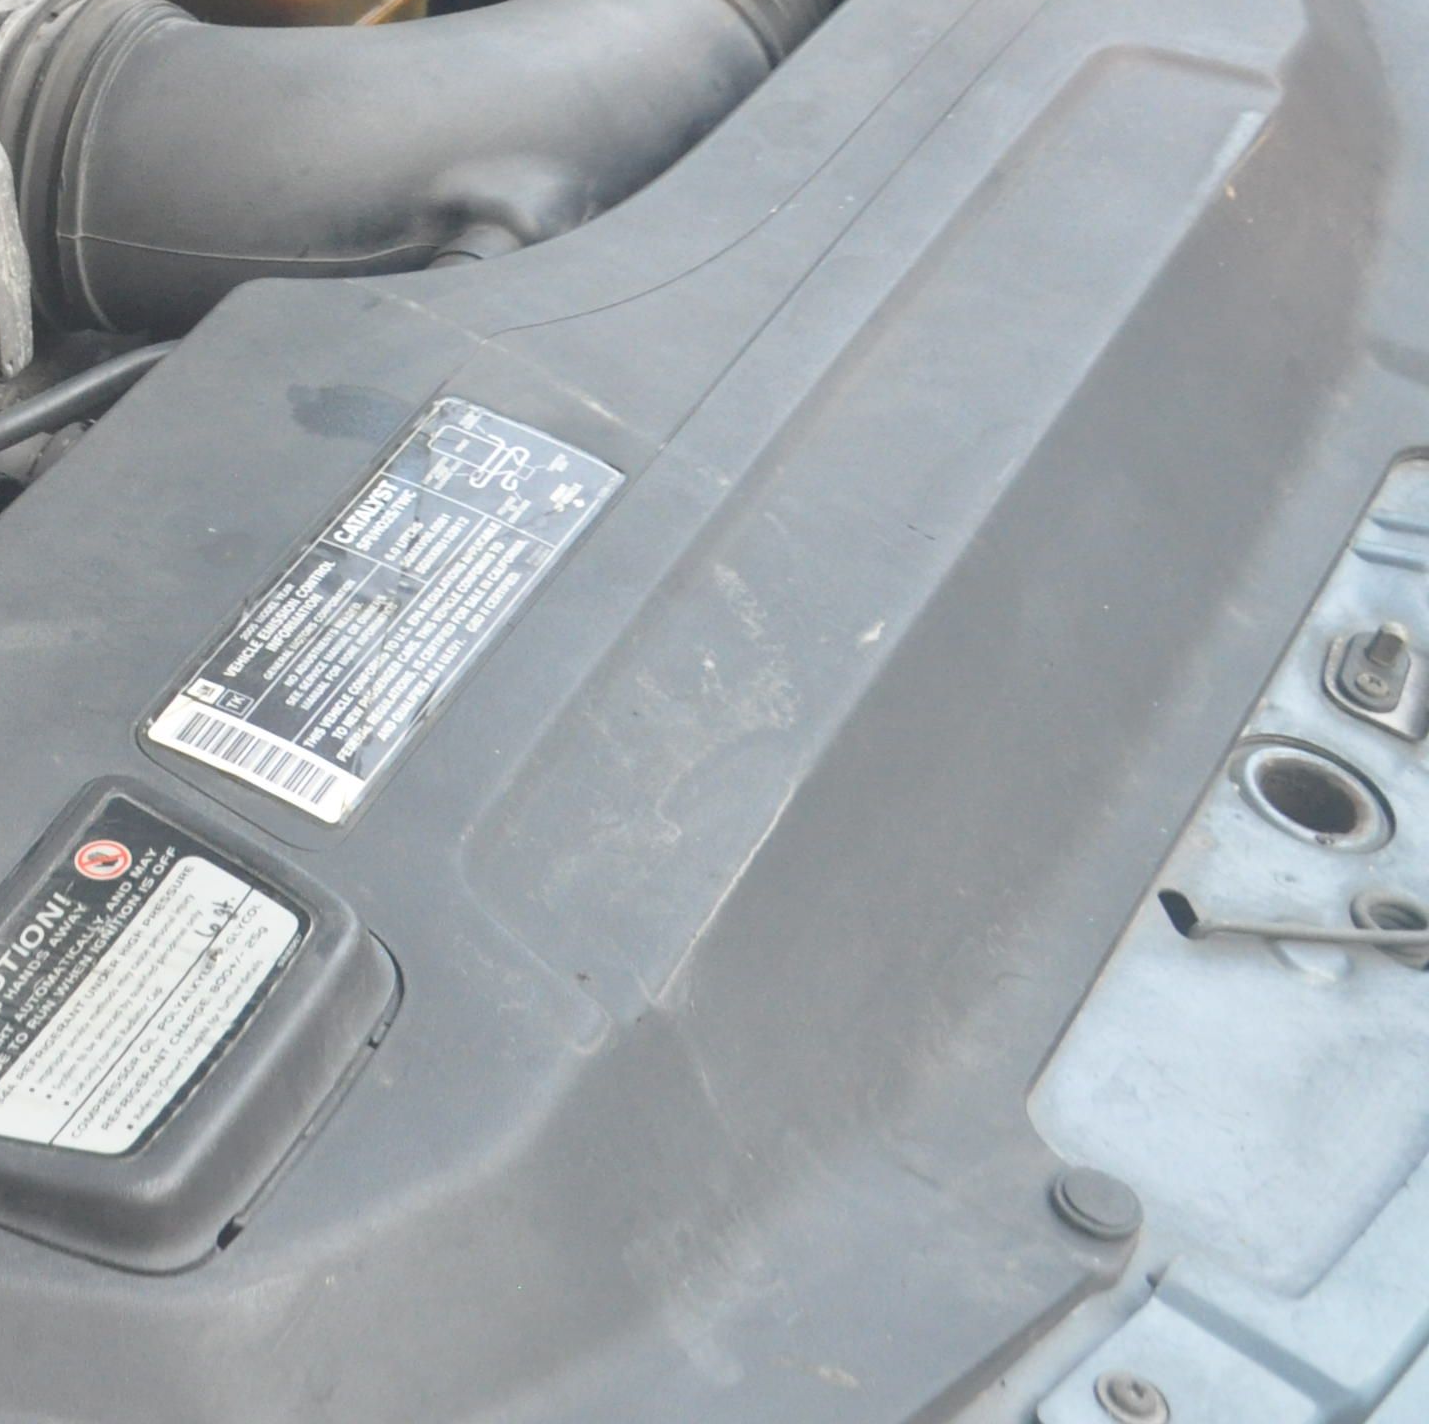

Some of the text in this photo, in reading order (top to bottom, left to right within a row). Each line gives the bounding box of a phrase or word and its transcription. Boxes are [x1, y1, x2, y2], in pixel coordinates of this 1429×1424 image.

[330, 478, 401, 545] CATALYST
[458, 520, 502, 564] APPLICABLE
[417, 560, 468, 612] REGULATIONS
[463, 587, 489, 609] SALE
[478, 578, 496, 591] IN
[223, 557, 336, 679] VEHICLE EMISSION CONTROL
[261, 577, 357, 681] GENERAL MOTORS CORPORATION
[264, 592, 324, 653] INFORMATION
[330, 724, 349, 740] TO
[340, 705, 366, 728] NEW
[356, 660, 405, 709] PASSENGER
[414, 619, 439, 640] THIS
[429, 590, 464, 623] VEHICLE
[454, 550, 497, 593] CONFORMS
[487, 540, 506, 554] TO
[391, 623, 414, 642] U.S.
[404, 608, 427, 627] EPA
[418, 621, 460, 662] CERTIFIED
[449, 605, 473, 625] FOR
[282, 673, 300, 687] NO
[293, 627, 340, 675] ADJUSTMENTS
[284, 689, 304, 706] SEE
[297, 659, 330, 691] SERVICE
[322, 633, 353, 662] MANUAL
[345, 622, 362, 635] OR
[382, 639, 401, 653] TO
[410, 658, 428, 671] IS
[225, 693, 246, 710] TK
[299, 679, 331, 711] MANUAL
[324, 664, 345, 681] FOR
[337, 644, 362, 666] MORE
[364, 667, 421, 726] REGULATIONS,
[372, 718, 398, 741] AND
[388, 679, 432, 723] QUALIFIES
[421, 668, 441, 683] AS
[301, 725, 327, 748] THIS
[317, 692, 355, 729] VEHICLE
[102, 879, 134, 912] AND
[127, 846, 160, 879] MAY
[0, 948, 52, 1001] HANDS
[44, 900, 90, 948] AWAY
[5, 1030, 31, 1051] TO
[23, 998, 57, 1030] RUN
[50, 953, 95, 998] WHEN
[86, 892, 143, 953] IGNITION
[135, 875, 156, 893] IS
[148, 844, 180, 875] OFF
[146, 915, 177, 948] personal
[13, 999, 87, 1081] REFRIGERANT
[81, 957, 122, 1000] UNDER
[116, 928, 145, 957] HIGH
[139, 863, 195, 927] PRESSURE
[74, 1052, 88, 1062] to
[82, 1040, 98, 1052] be
[185, 909, 205, 927] only
[69, 1055, 142, 1138] COMPRESSOR
[136, 1032, 160, 1054] OIL
[223, 900, 263, 945] GLYCOL
[99, 1046, 172, 1131] REFRIGERANT
[149, 1088, 163, 1098] to
